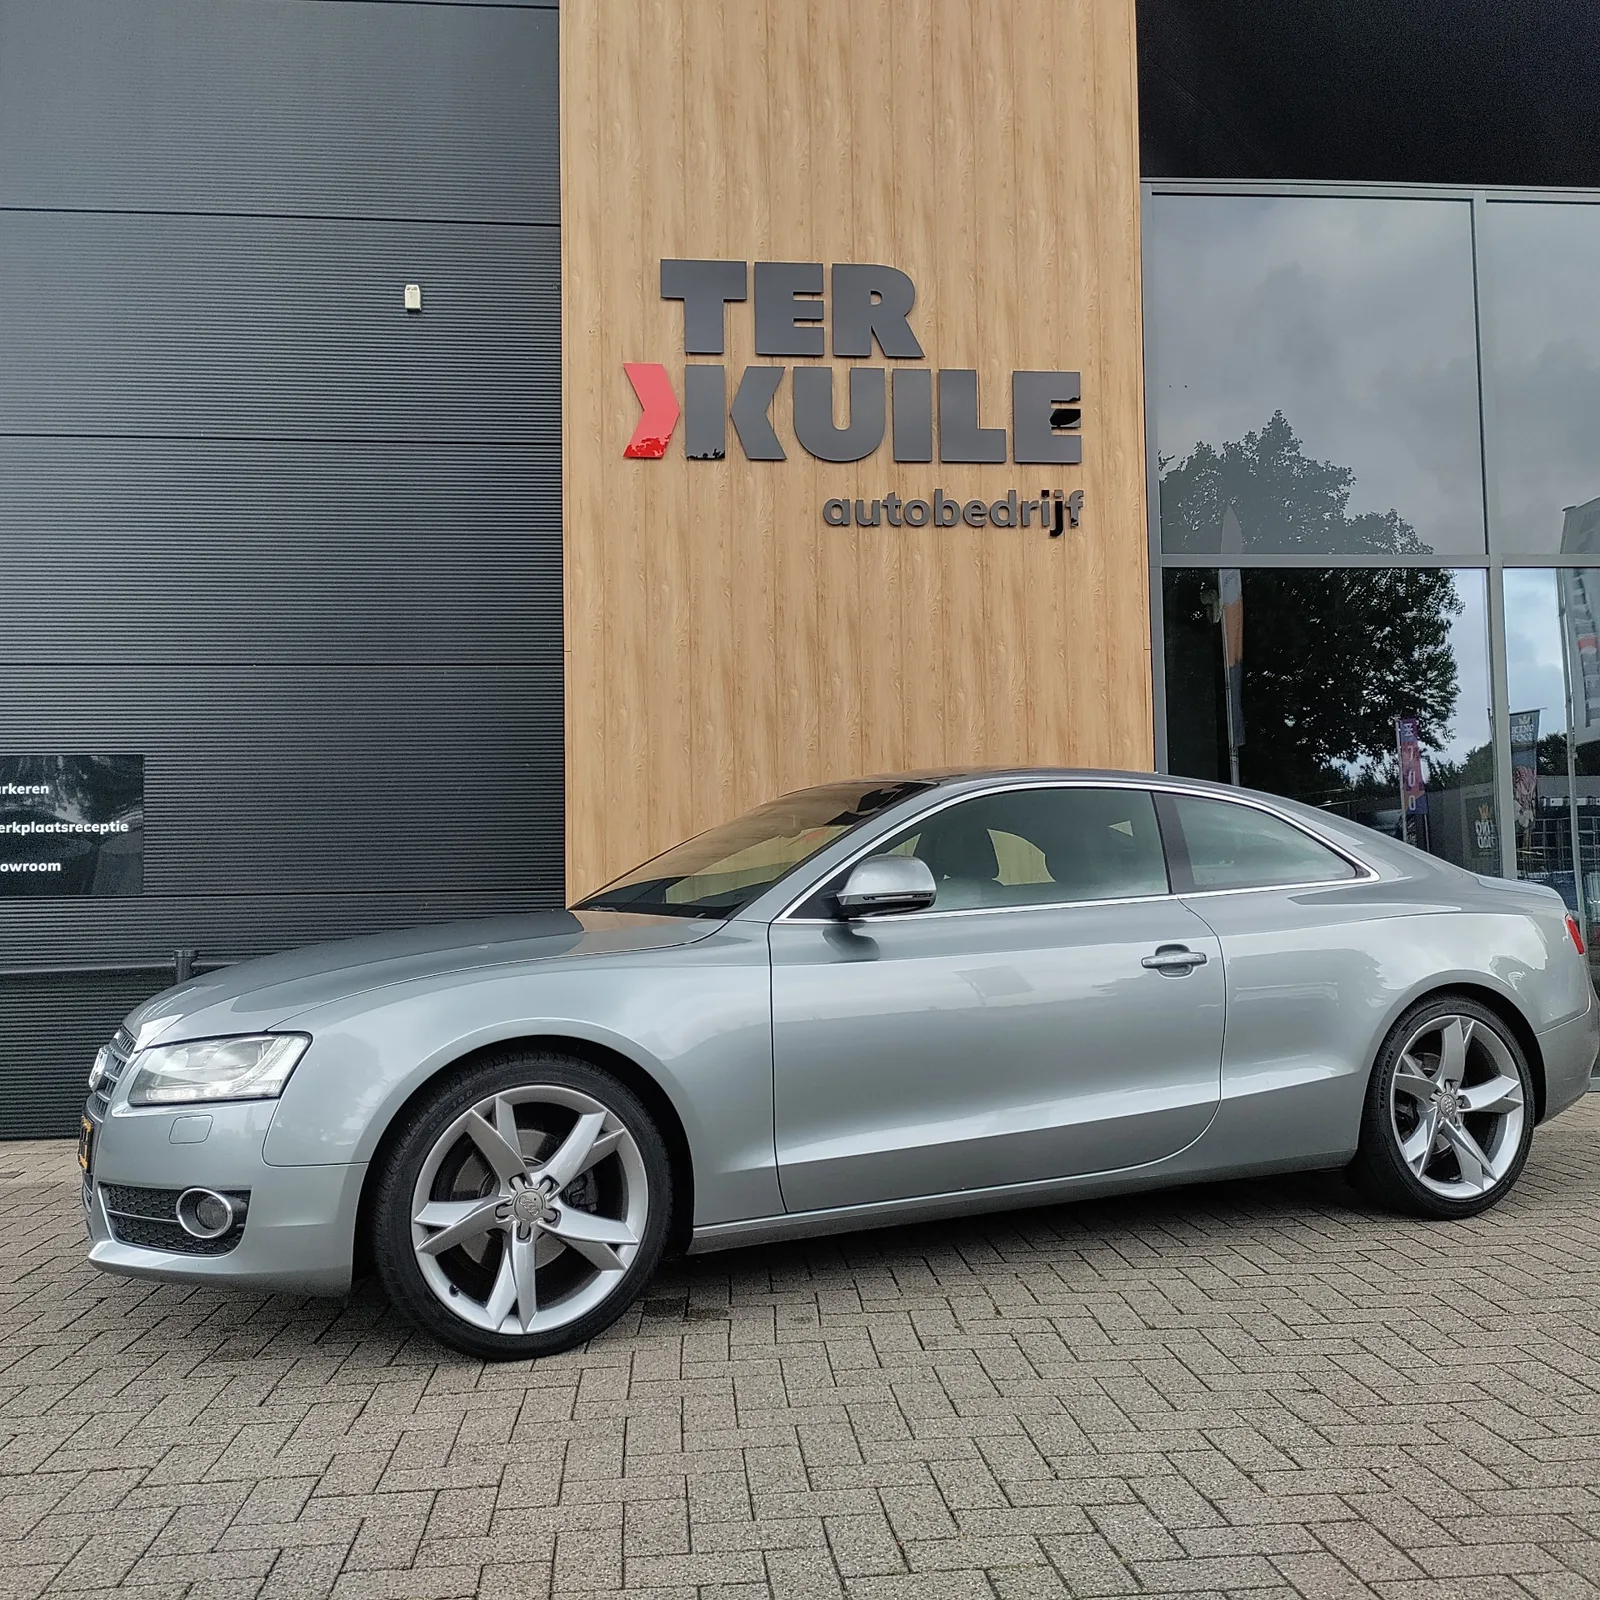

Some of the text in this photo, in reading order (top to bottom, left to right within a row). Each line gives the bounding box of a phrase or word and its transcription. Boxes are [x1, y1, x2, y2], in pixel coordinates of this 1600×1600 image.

[660, 258, 925, 358] TER
[684, 363, 1083, 465] KUILE
[823, 488, 1085, 538] autobedrijf
